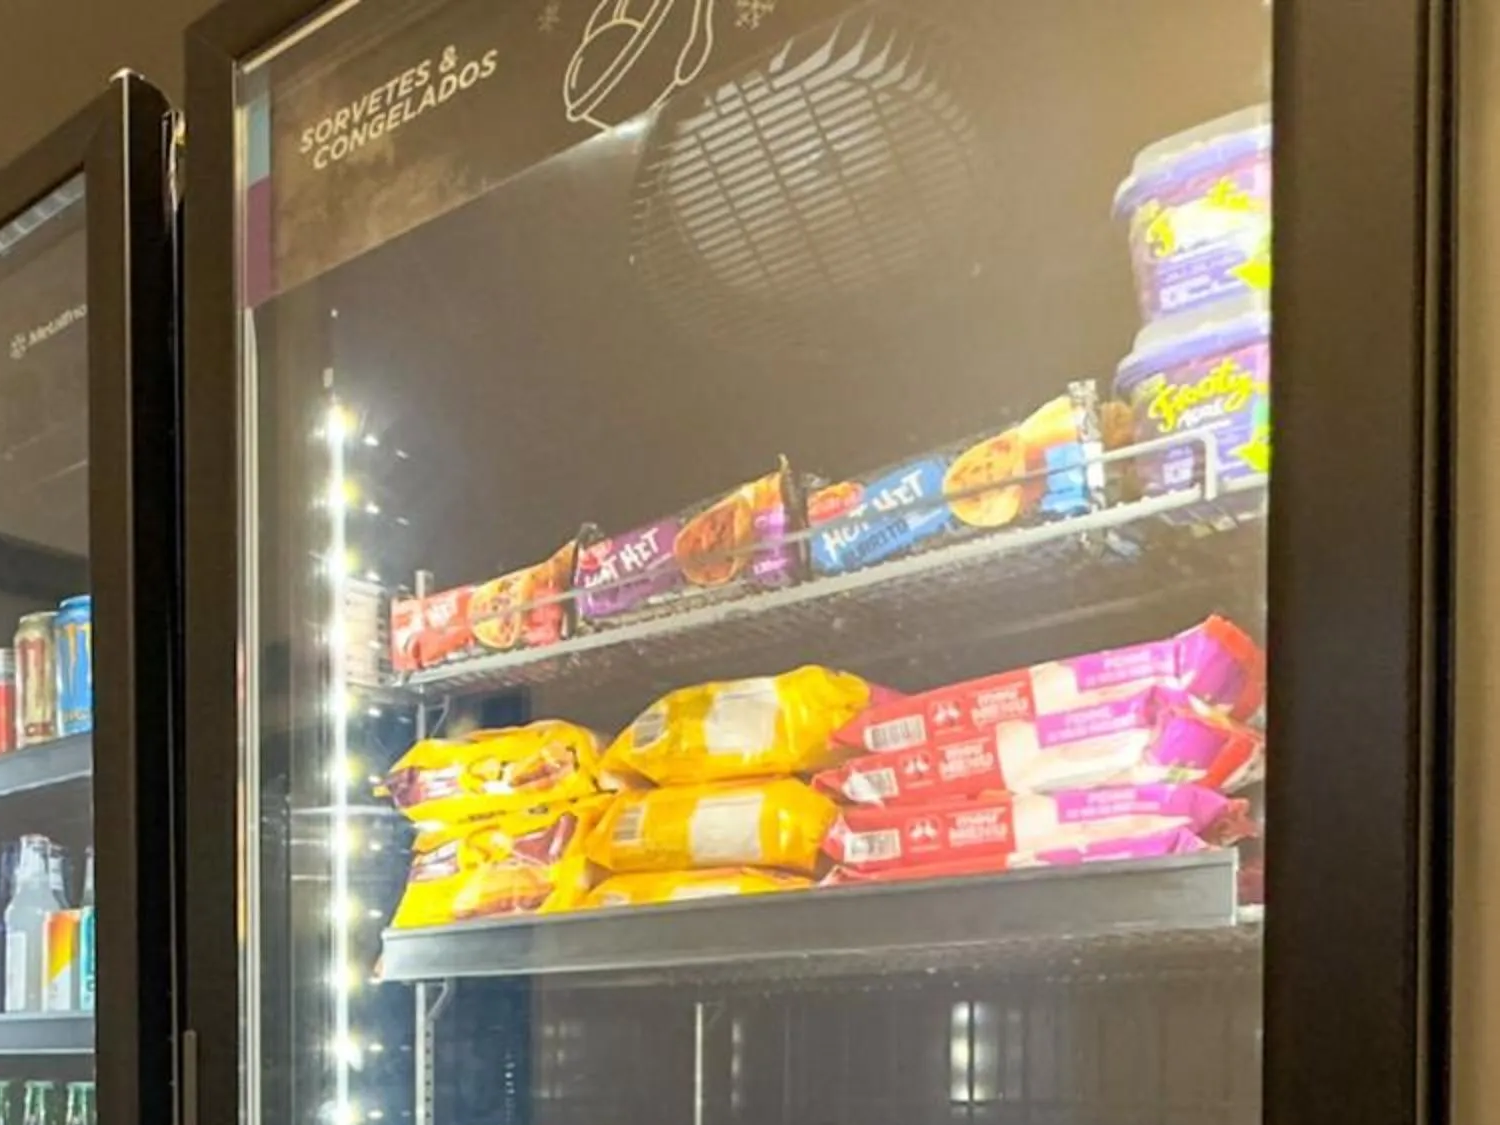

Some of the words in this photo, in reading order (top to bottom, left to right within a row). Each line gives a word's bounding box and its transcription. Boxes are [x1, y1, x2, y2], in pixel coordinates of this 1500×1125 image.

[299, 59, 431, 154] SORVETES
[438, 44, 458, 74] &
[312, 48, 499, 170] CONGELADOS
